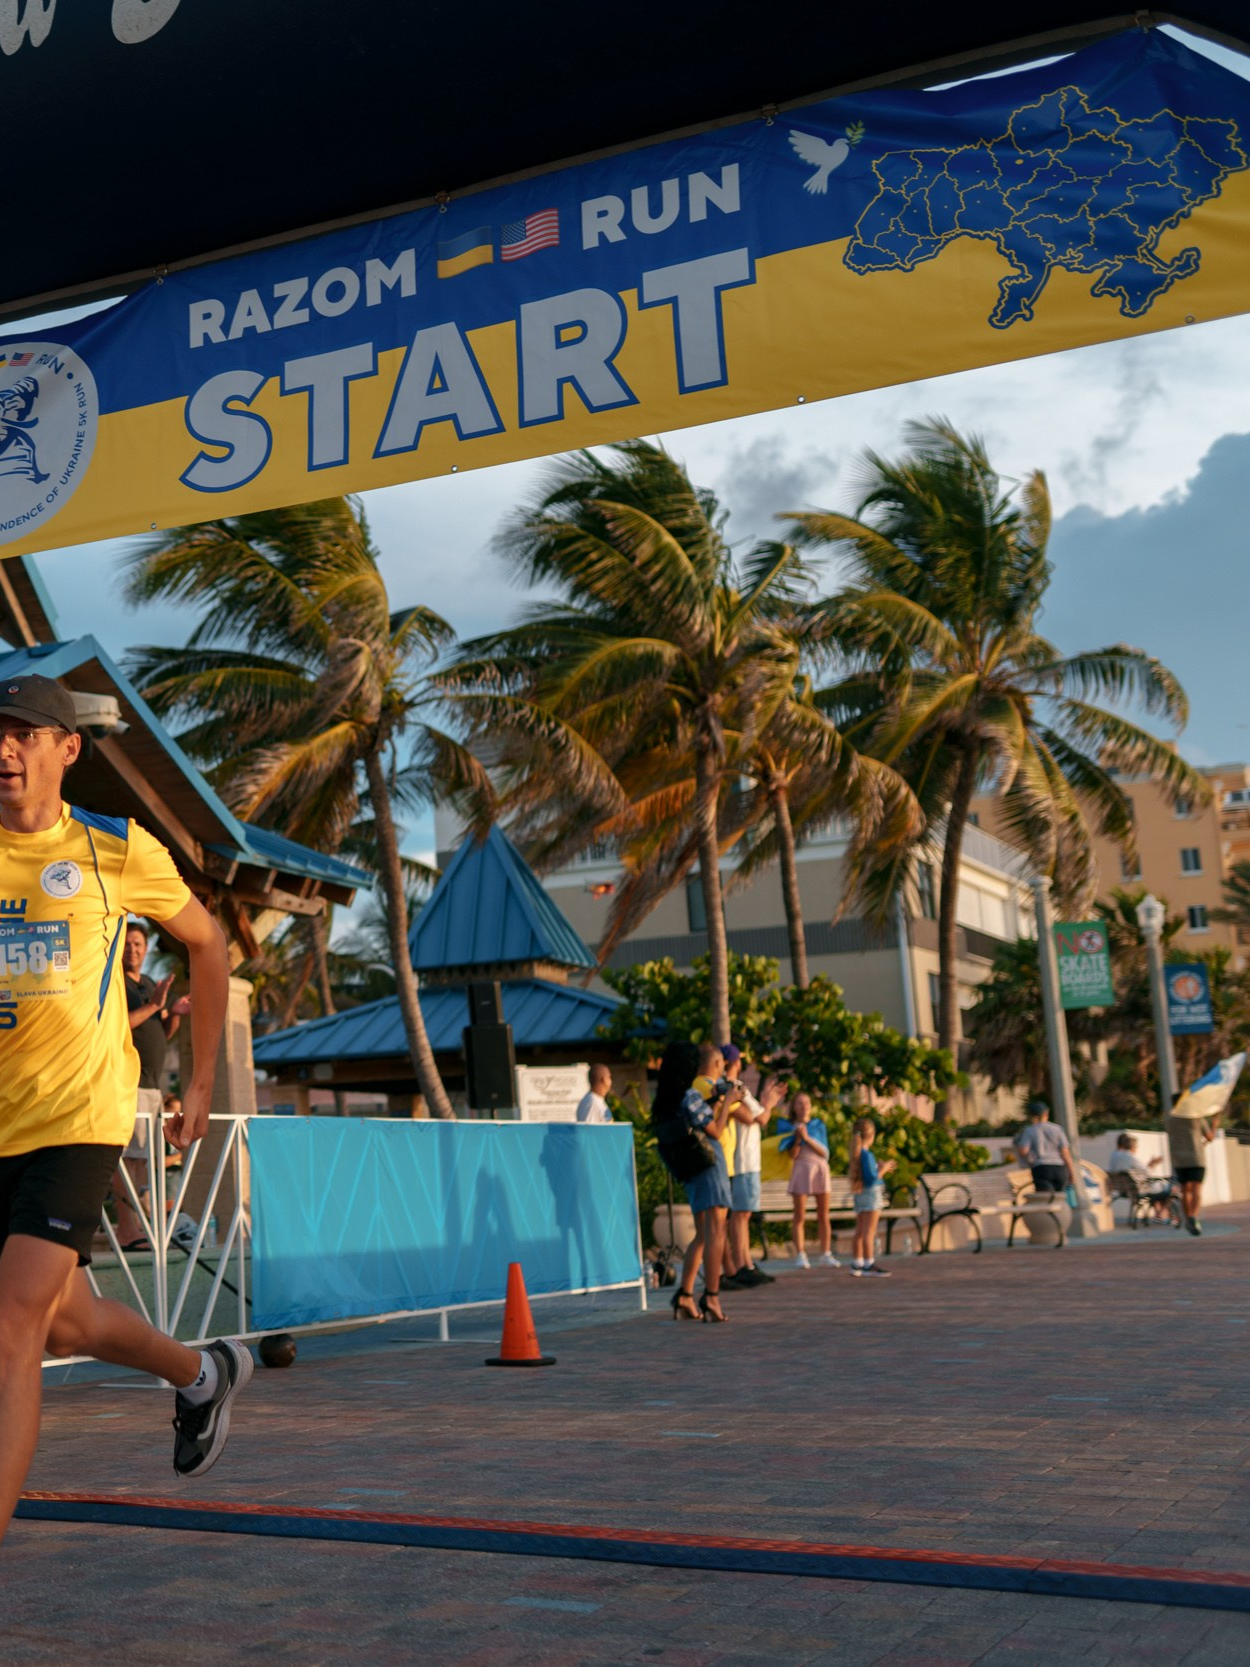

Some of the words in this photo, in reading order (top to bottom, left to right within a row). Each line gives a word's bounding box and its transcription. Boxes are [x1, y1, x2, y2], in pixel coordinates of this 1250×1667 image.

[188, 247, 418, 349] RAZOM
[580, 163, 742, 252] RUN
[36, 353, 66, 375] RUN
[178, 247, 757, 494] START
[73, 382, 88, 409] RUN
[78, 410, 89, 427] 5K
[59, 430, 86, 486] UKRAINE
[45, 486, 61, 504] OF
[36, 924, 60, 934] RUN
